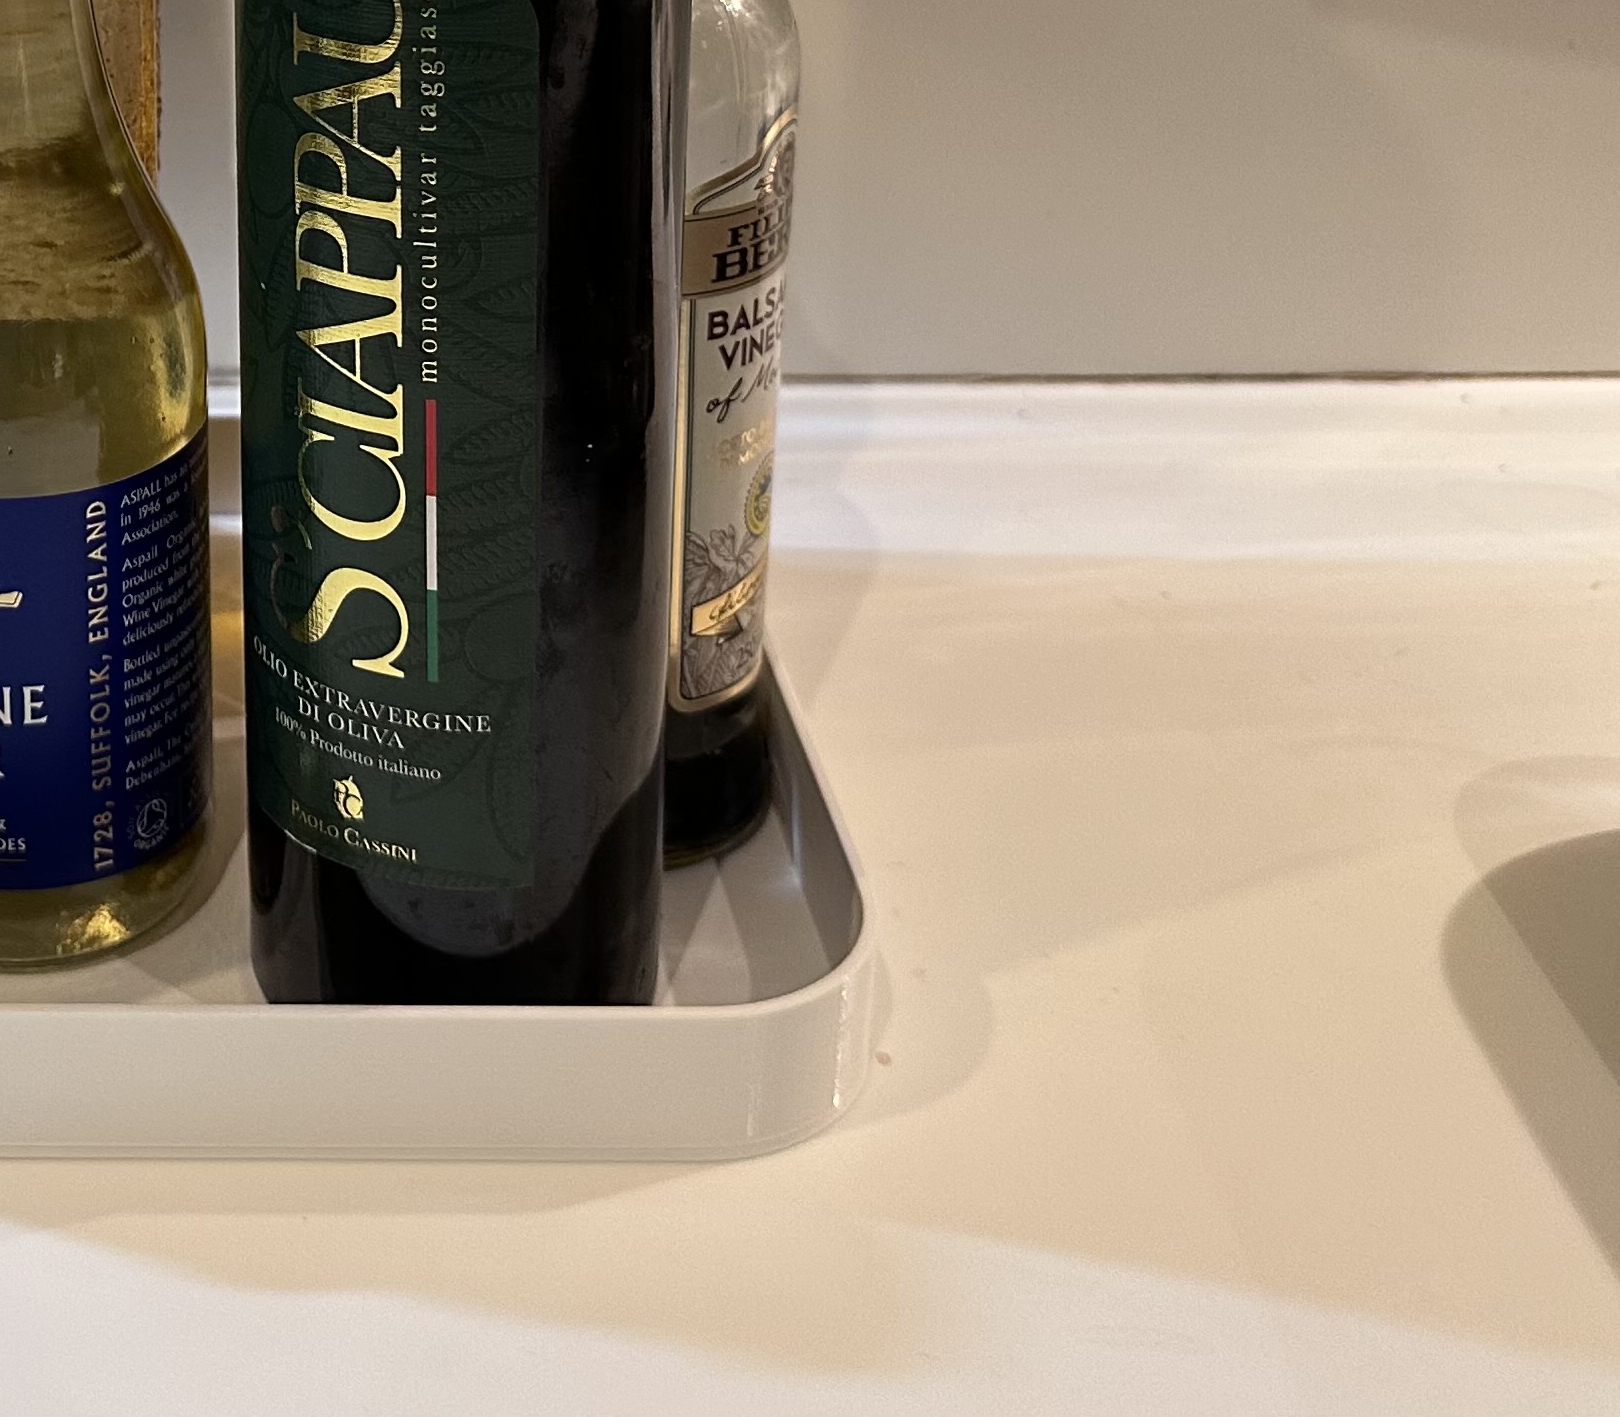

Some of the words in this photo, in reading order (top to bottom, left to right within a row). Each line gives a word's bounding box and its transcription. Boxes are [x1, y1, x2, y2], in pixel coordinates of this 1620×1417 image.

[413, 152, 438, 384] monocultivar
[120, 479, 162, 509] ASPALL
[138, 499, 161, 520] 1946
[86, 500, 109, 644] ENGLAND
[122, 544, 159, 572] Aspall
[122, 559, 169, 593] produced
[122, 606, 151, 628] Wine
[253, 635, 288, 678] OLIO
[293, 669, 492, 733] EXTRAVERGINE
[90, 654, 112, 791] SUFFOLK,
[124, 709, 147, 728] may
[275, 706, 307, 739] 100%
[310, 728, 374, 768] Prodotto
[378, 754, 442, 781] italiano
[298, 695, 320, 723] DI
[328, 711, 405, 749] OLIVA
[93, 800, 115, 872] 1728,
[291, 798, 340, 839] PAOLO
[344, 828, 418, 864] CASSINI
